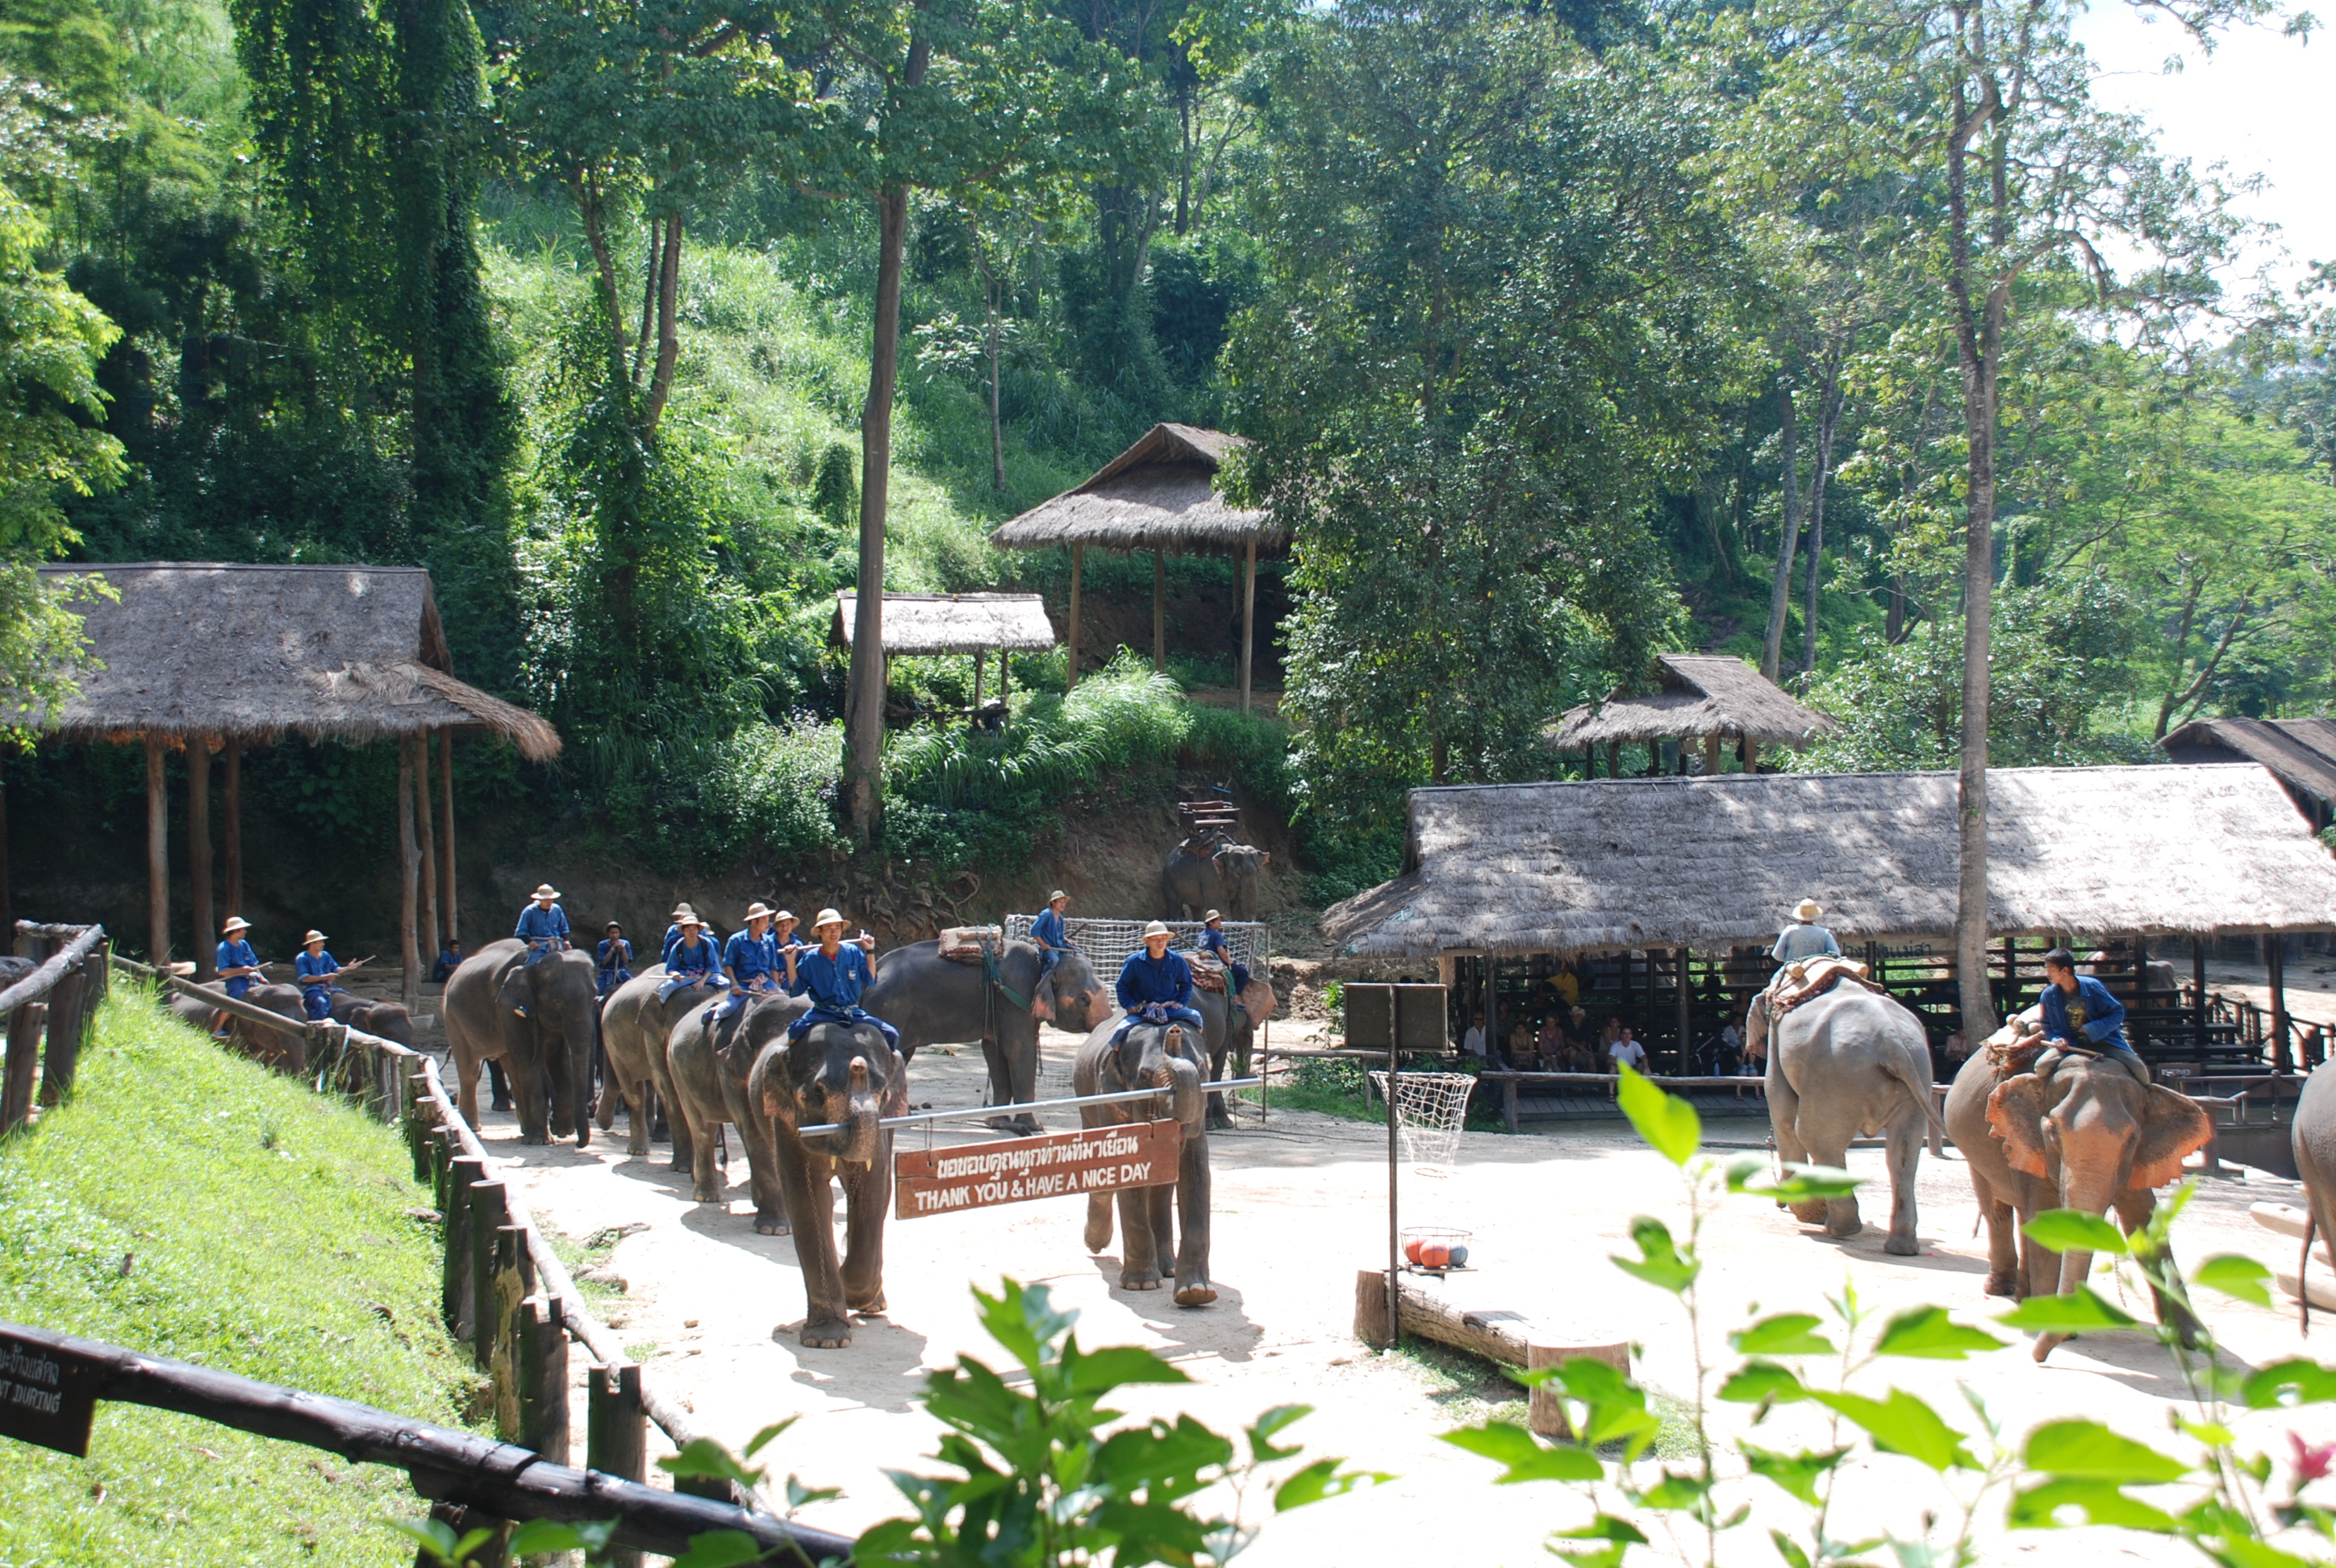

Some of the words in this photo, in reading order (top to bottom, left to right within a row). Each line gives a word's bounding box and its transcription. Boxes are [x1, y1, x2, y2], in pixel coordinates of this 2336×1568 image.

[937, 1130, 1139, 1181] ขอขอบคุณทุกท่านที่มาเยือน
[915, 1185, 971, 1211] THANK
[974, 1179, 1008, 1203] YOU
[1011, 1180, 1024, 1199] &
[1025, 1174, 1064, 1195] HAVE
[1066, 1171, 1079, 1191] A
[1082, 1166, 1116, 1189] NICE
[1120, 1161, 1152, 1184] DAY
[13, 1383, 62, 1414] DURING
